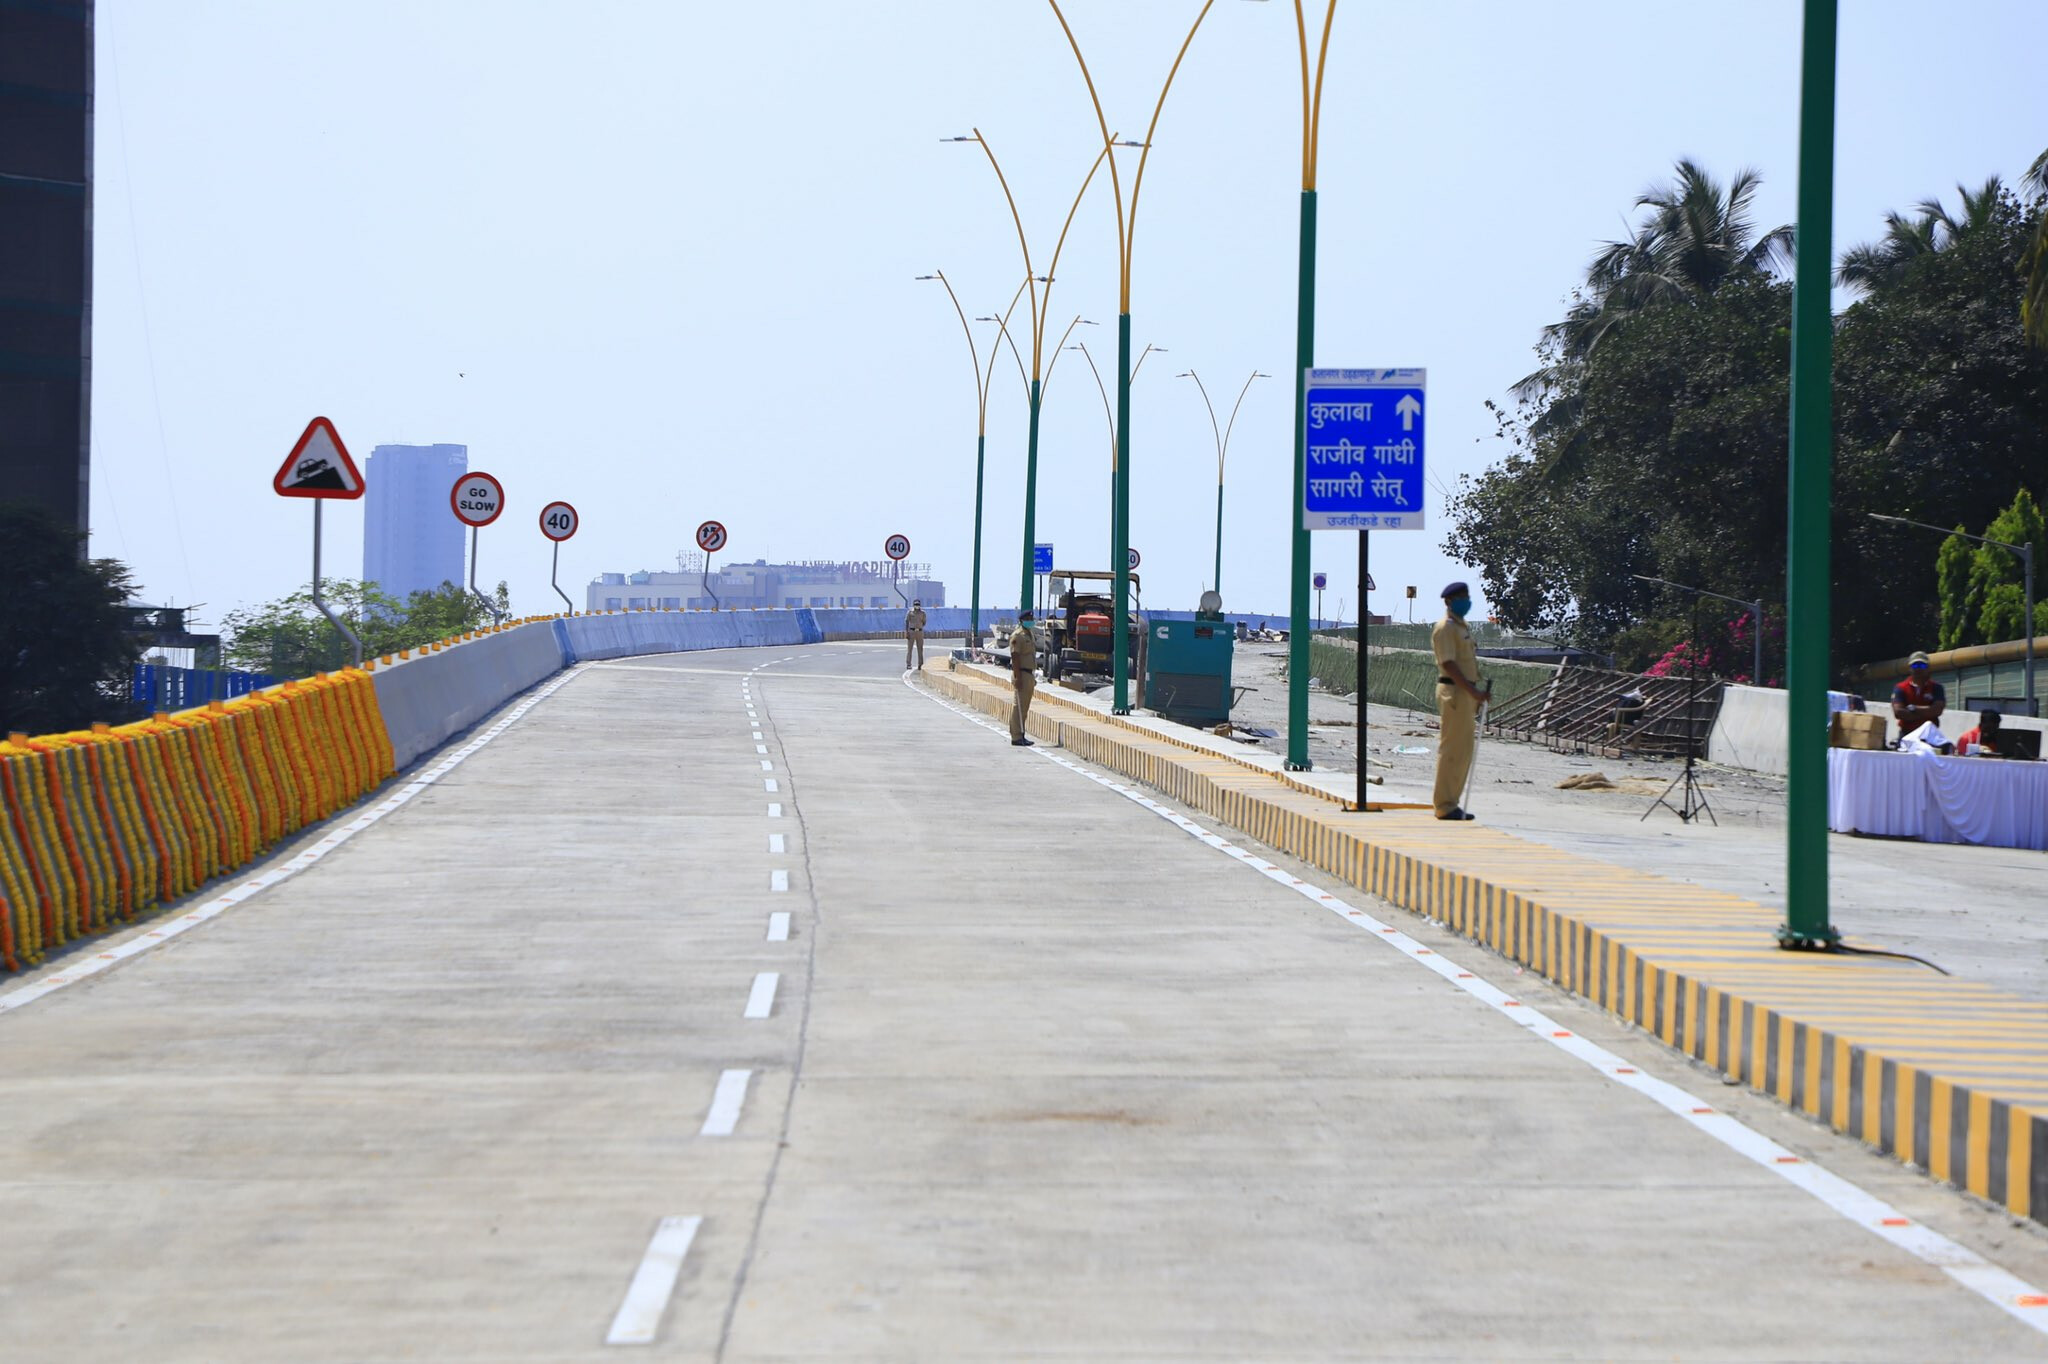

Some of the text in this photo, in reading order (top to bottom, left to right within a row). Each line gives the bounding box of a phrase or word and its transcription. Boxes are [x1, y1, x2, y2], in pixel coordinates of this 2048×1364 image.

[1310, 402, 1373, 429] कुलाबा
[1309, 438, 1416, 465] राजीव गांधी
[469, 488, 487, 498] GO
[1309, 472, 1408, 506] सागरी सेतू
[460, 500, 495, 512] SLOW
[547, 513, 570, 530] 40
[890, 541, 905, 553] 40
